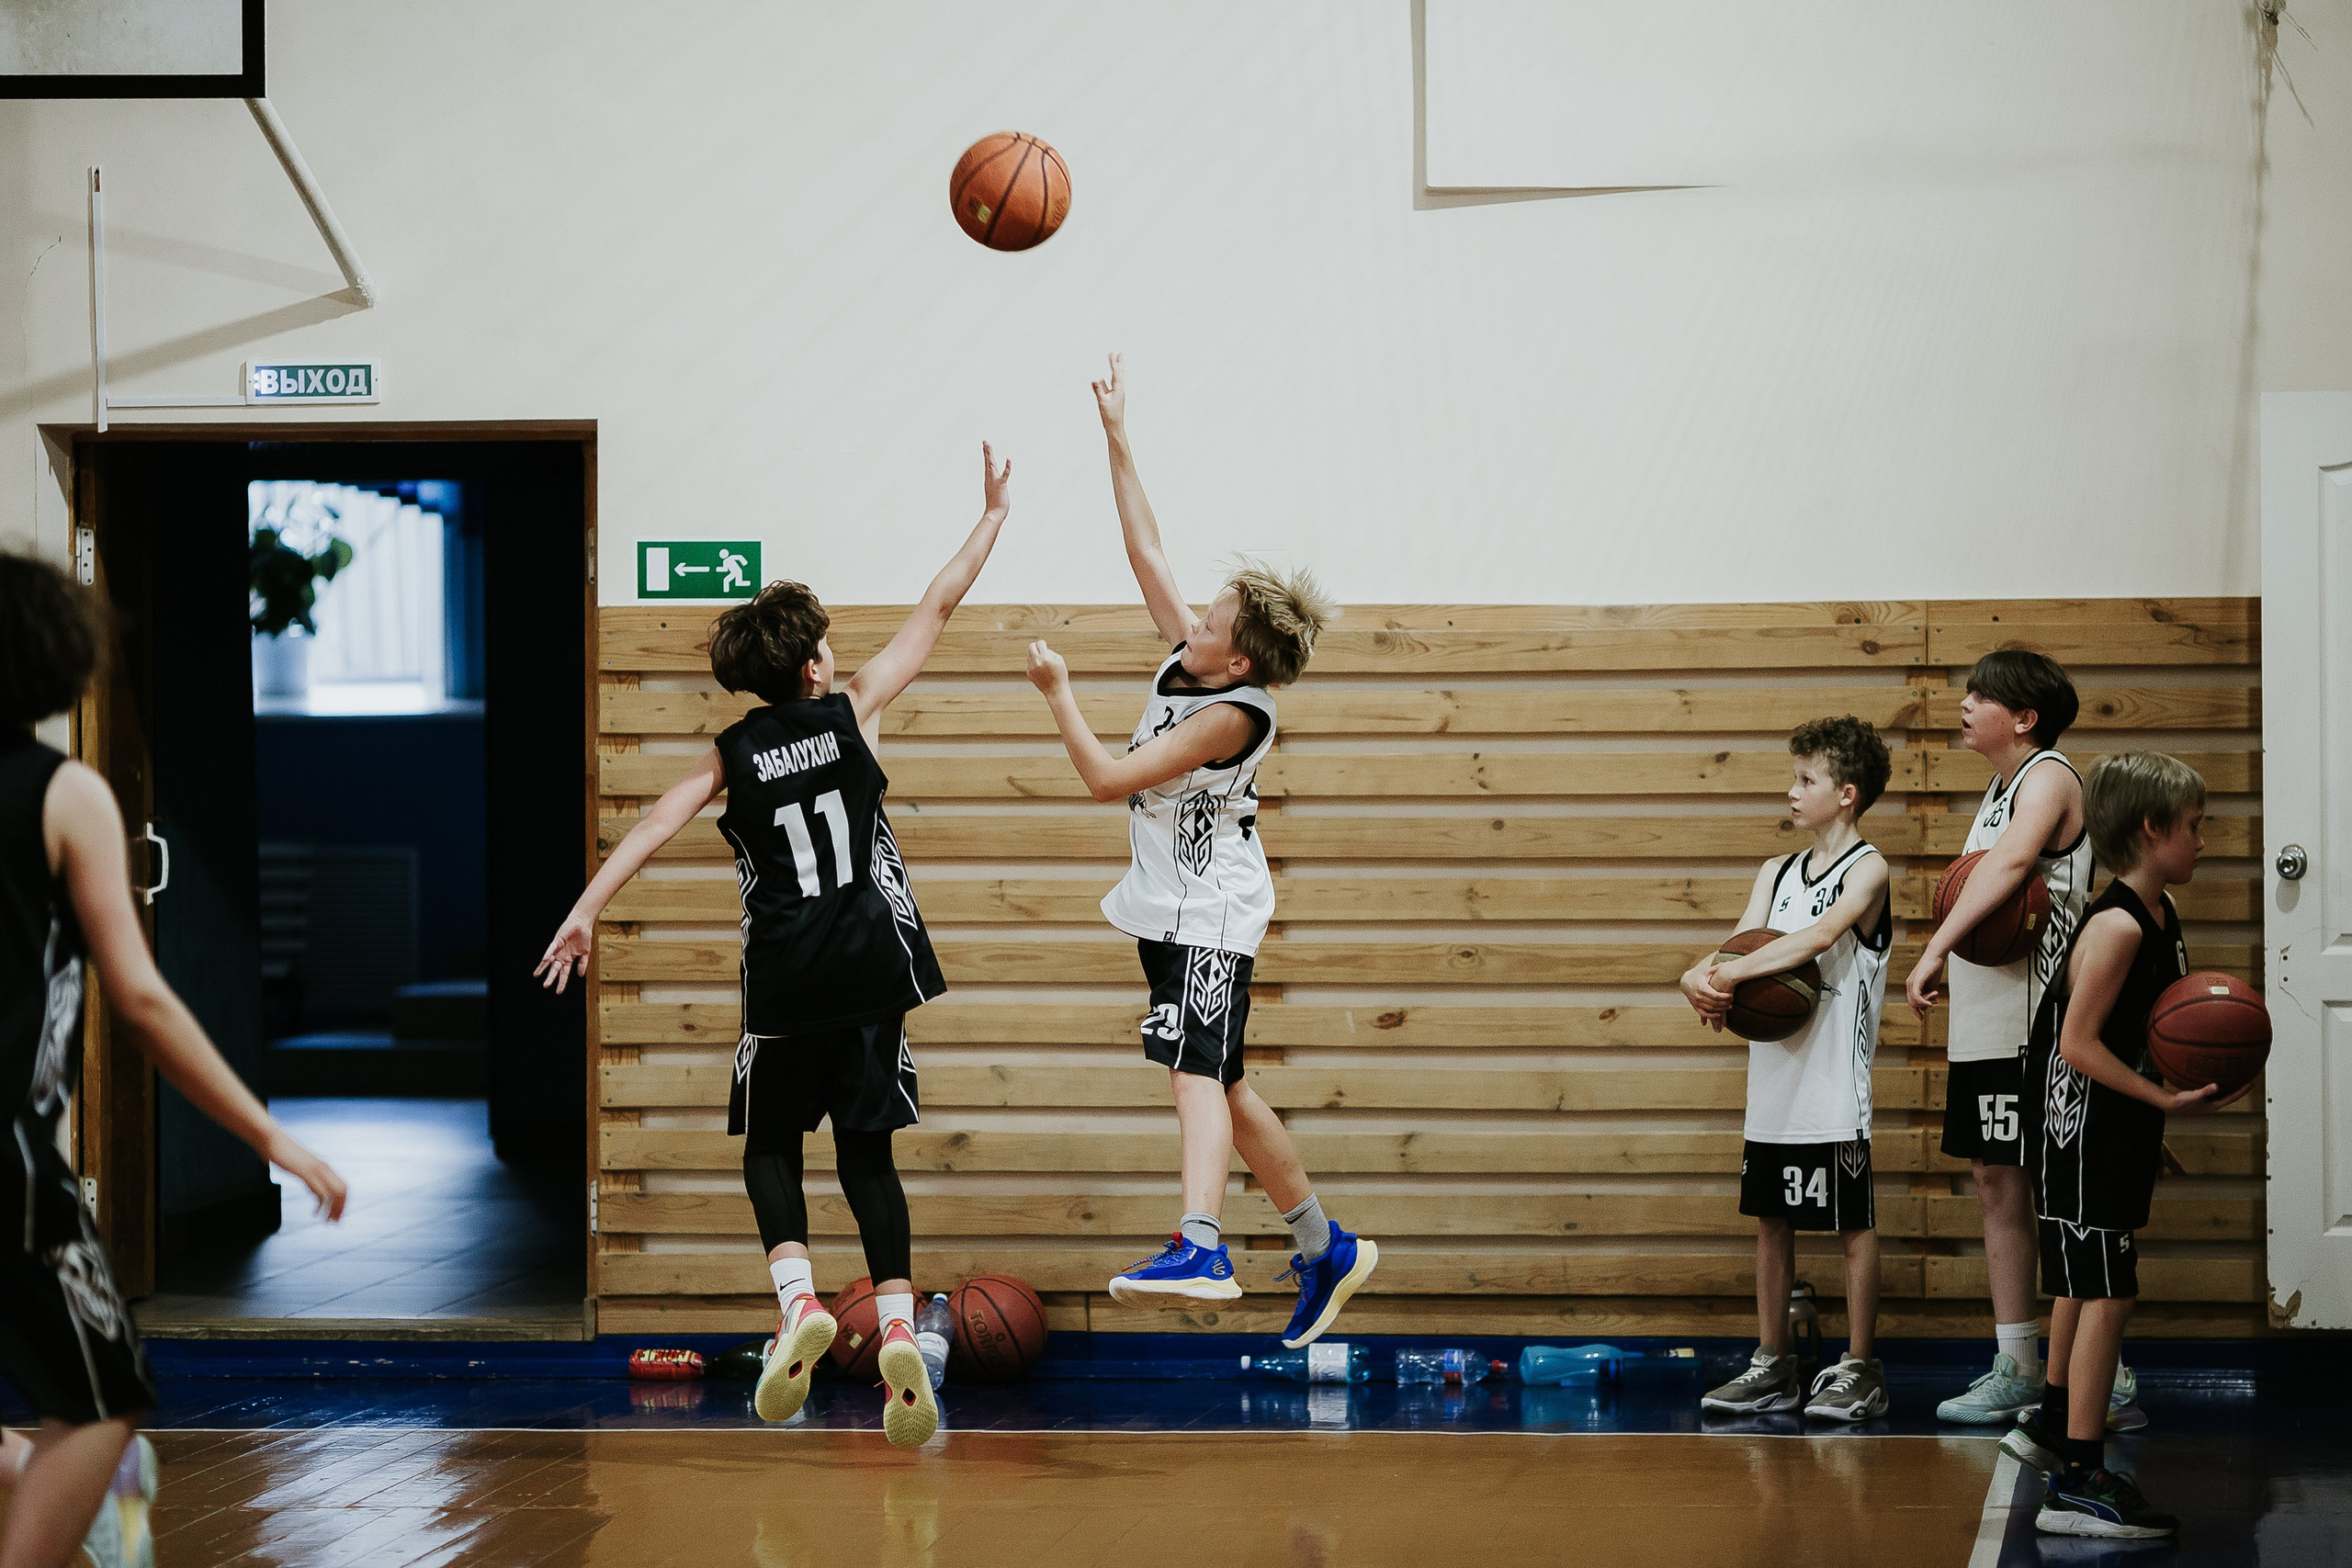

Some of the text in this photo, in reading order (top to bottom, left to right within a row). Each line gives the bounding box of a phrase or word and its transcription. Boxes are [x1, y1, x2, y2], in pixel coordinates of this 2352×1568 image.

[260, 368, 368, 395] ВЫХОД
[752, 731, 841, 783] ЗАБАЛУХИН
[774, 789, 853, 897] 11
[1978, 1094, 2018, 1141] 55
[1782, 1166, 1828, 1207] 34
